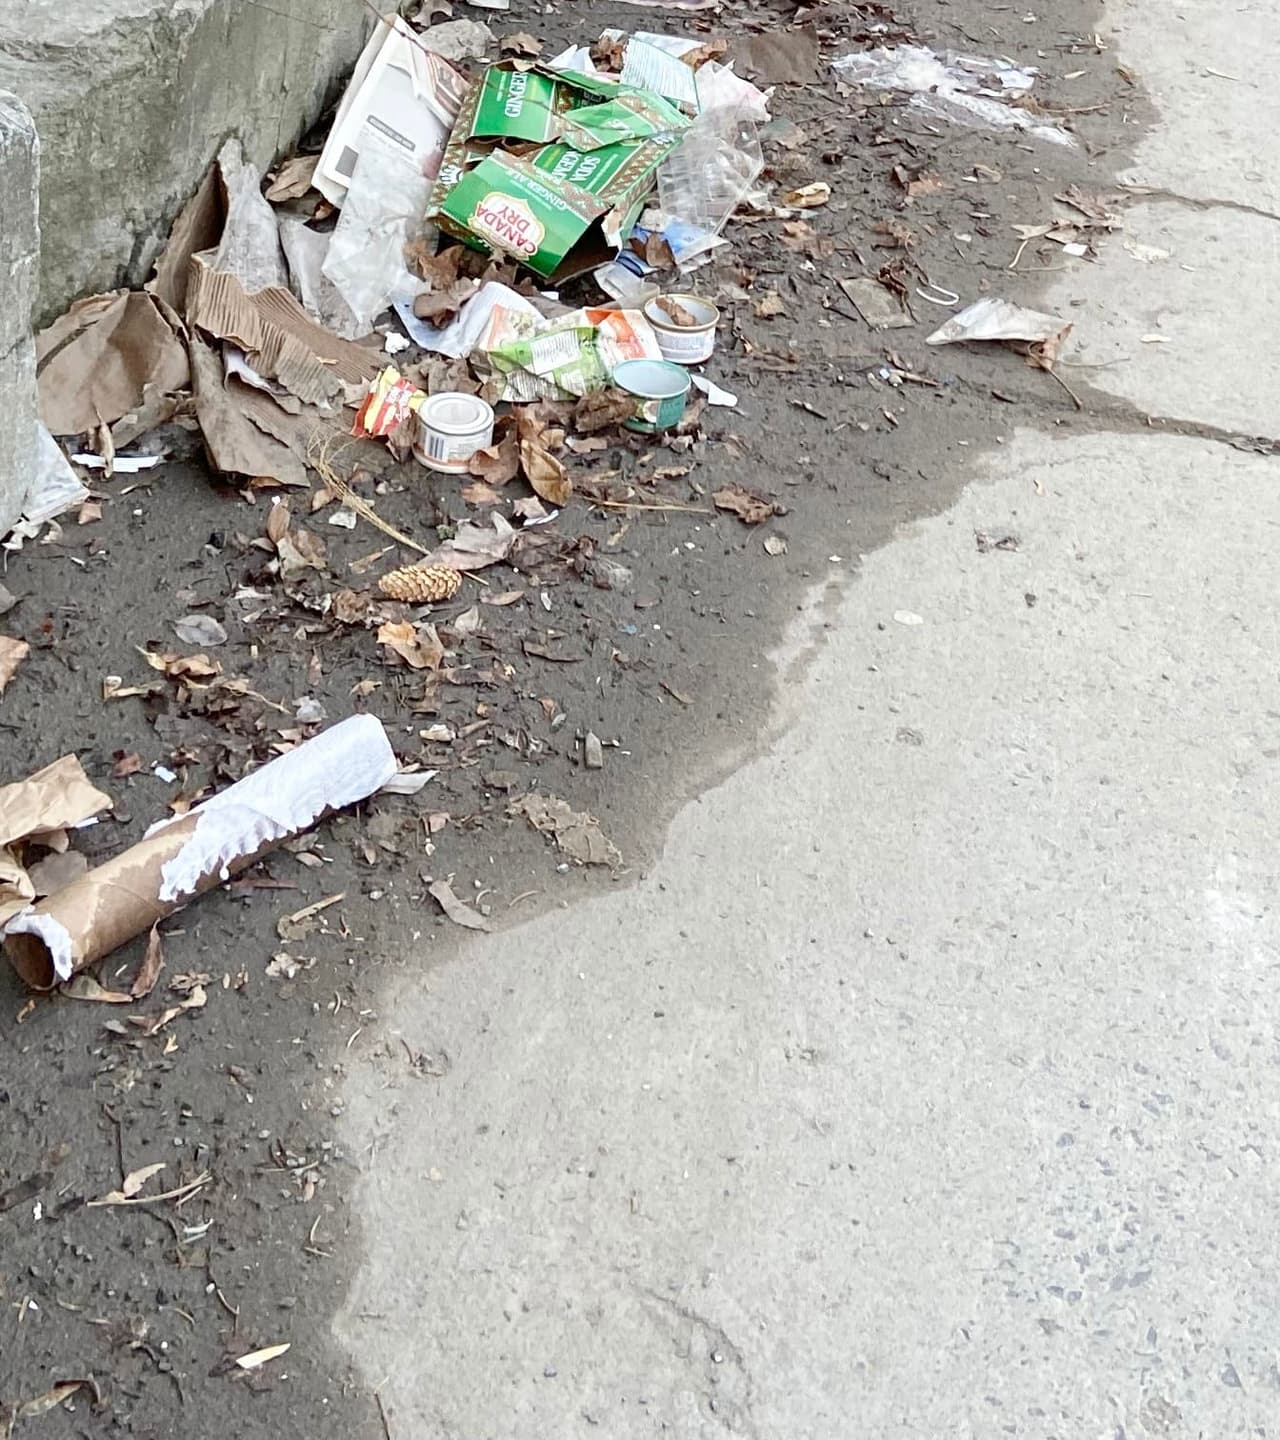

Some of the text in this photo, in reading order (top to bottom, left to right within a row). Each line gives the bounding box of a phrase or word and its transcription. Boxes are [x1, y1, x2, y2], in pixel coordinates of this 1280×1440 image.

[570, 155, 601, 182] SODA
[526, 178, 568, 211] GINGER
[476, 204, 536, 254] CANADA
[499, 206, 530, 233] DRY
